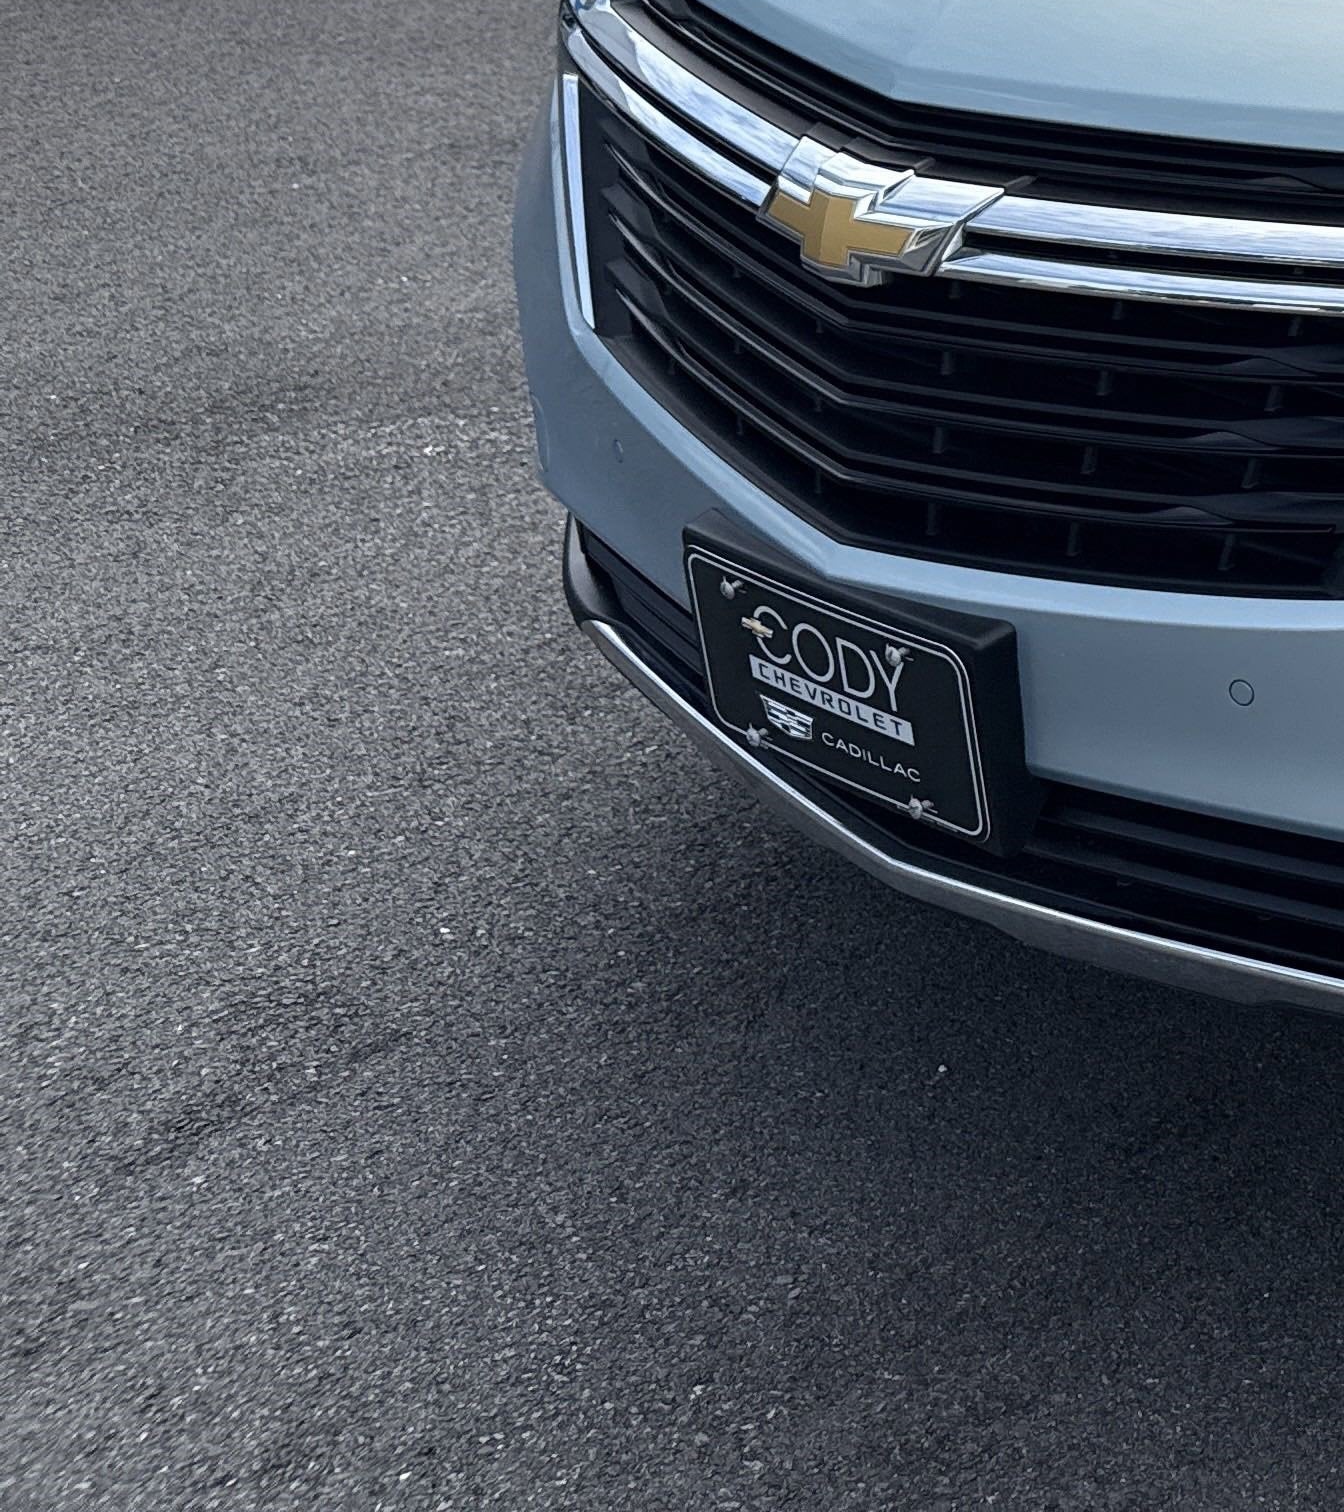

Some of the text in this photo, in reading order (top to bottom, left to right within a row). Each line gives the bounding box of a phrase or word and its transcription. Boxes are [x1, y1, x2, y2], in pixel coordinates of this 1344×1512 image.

[752, 604, 905, 713] CODY
[757, 662, 904, 737] CHEVROLET
[821, 732, 921, 783] CADILLAC
